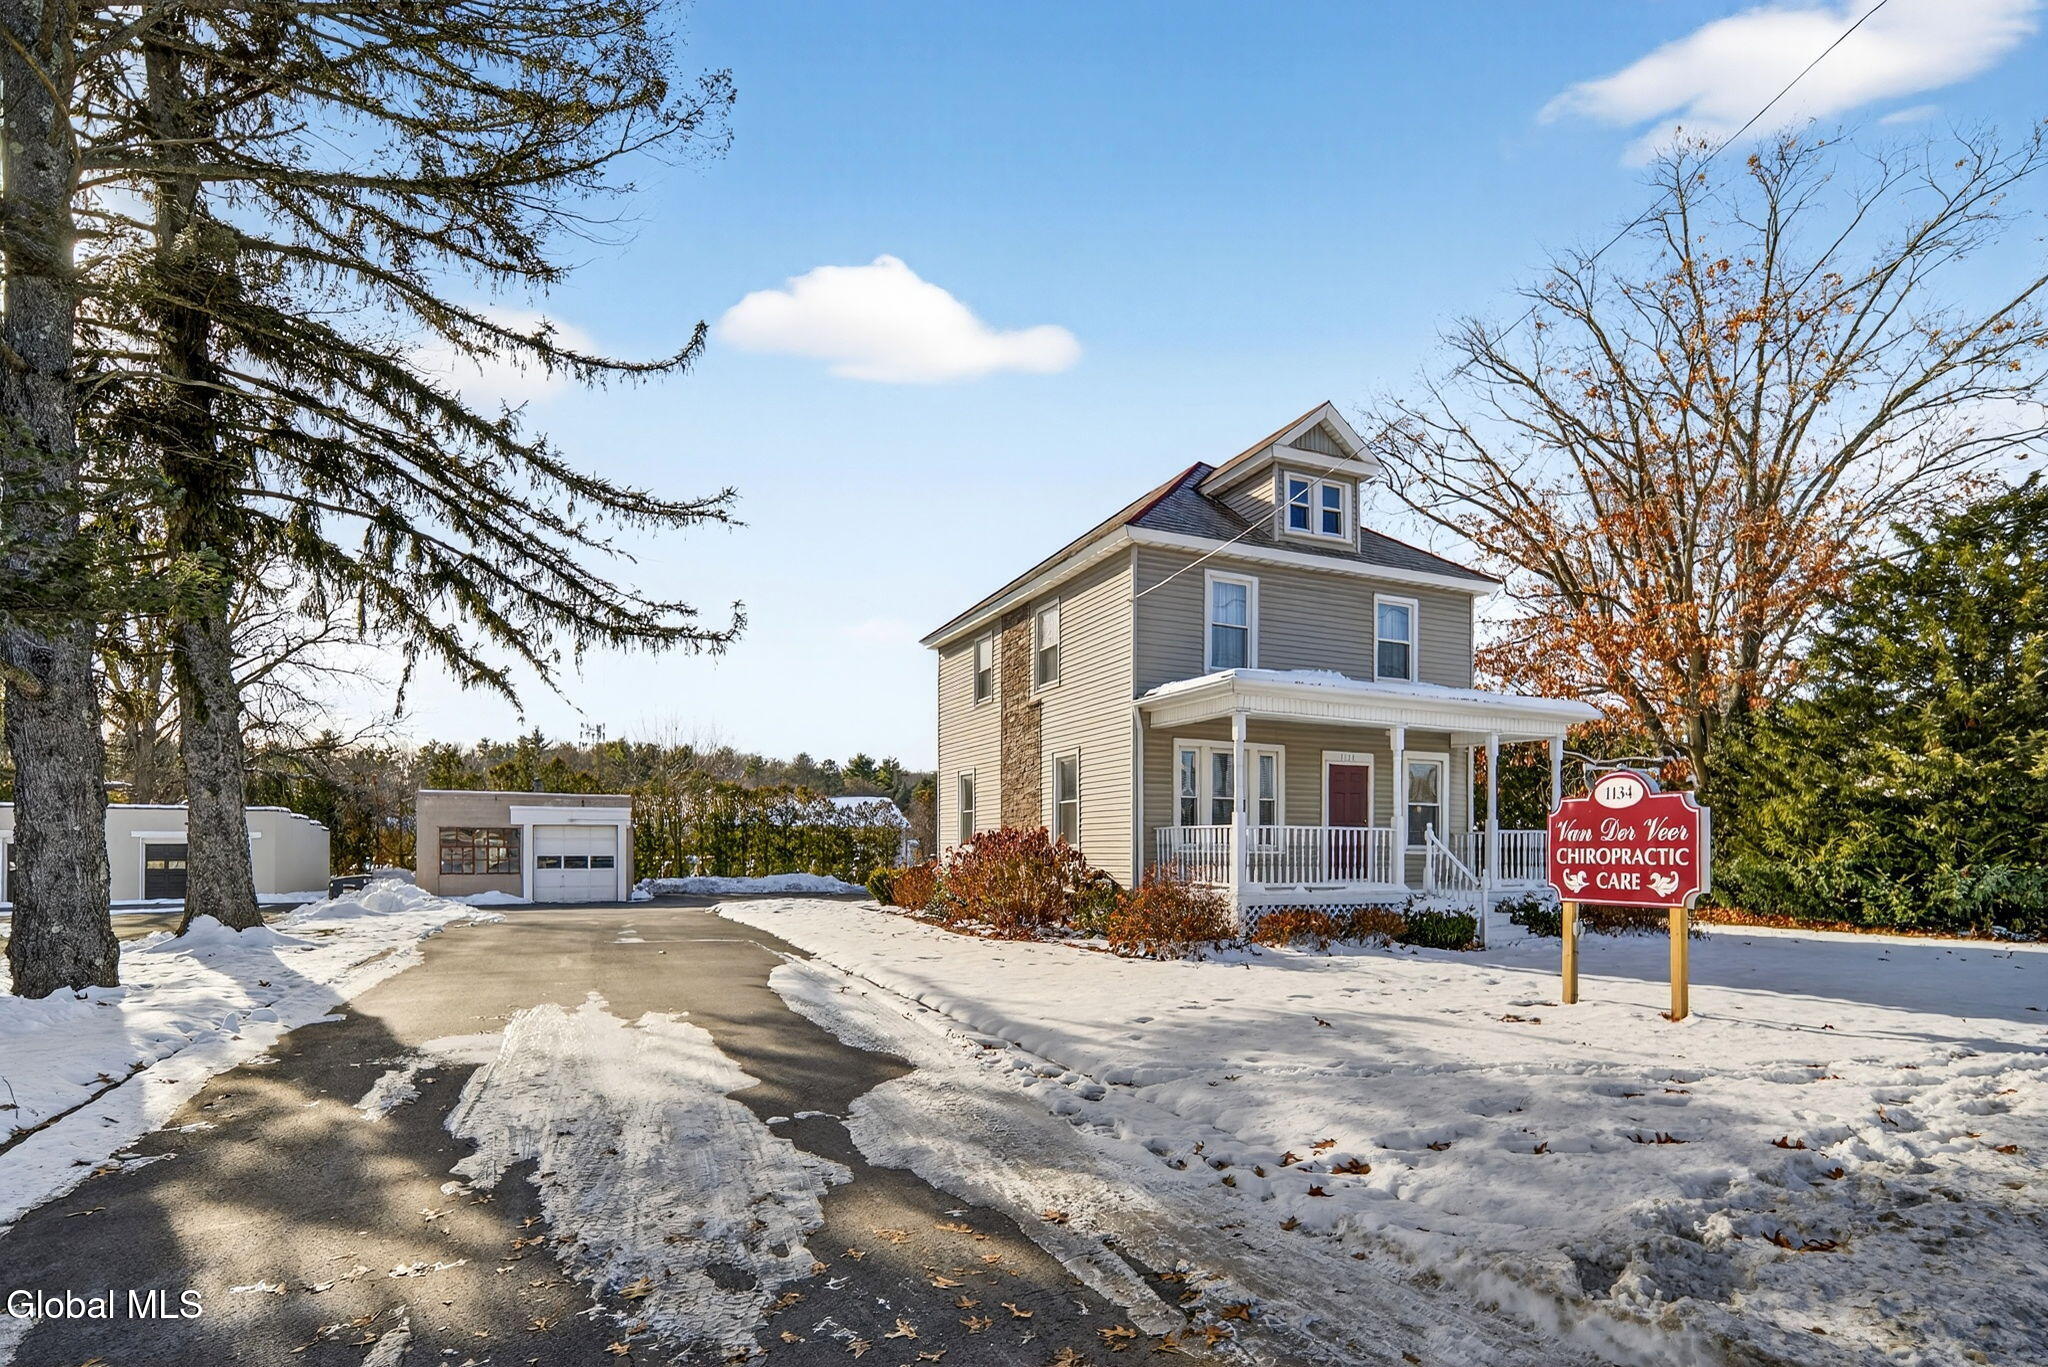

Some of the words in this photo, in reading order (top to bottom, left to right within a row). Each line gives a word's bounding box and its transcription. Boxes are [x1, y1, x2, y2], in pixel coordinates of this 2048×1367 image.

[1605, 785, 1633, 800] 1134
[1556, 819, 1592, 842] Van
[1643, 816, 1689, 841] Veer
[1556, 847, 1690, 866] CHIROPRACTIC
[1596, 872, 1641, 890] CARE
